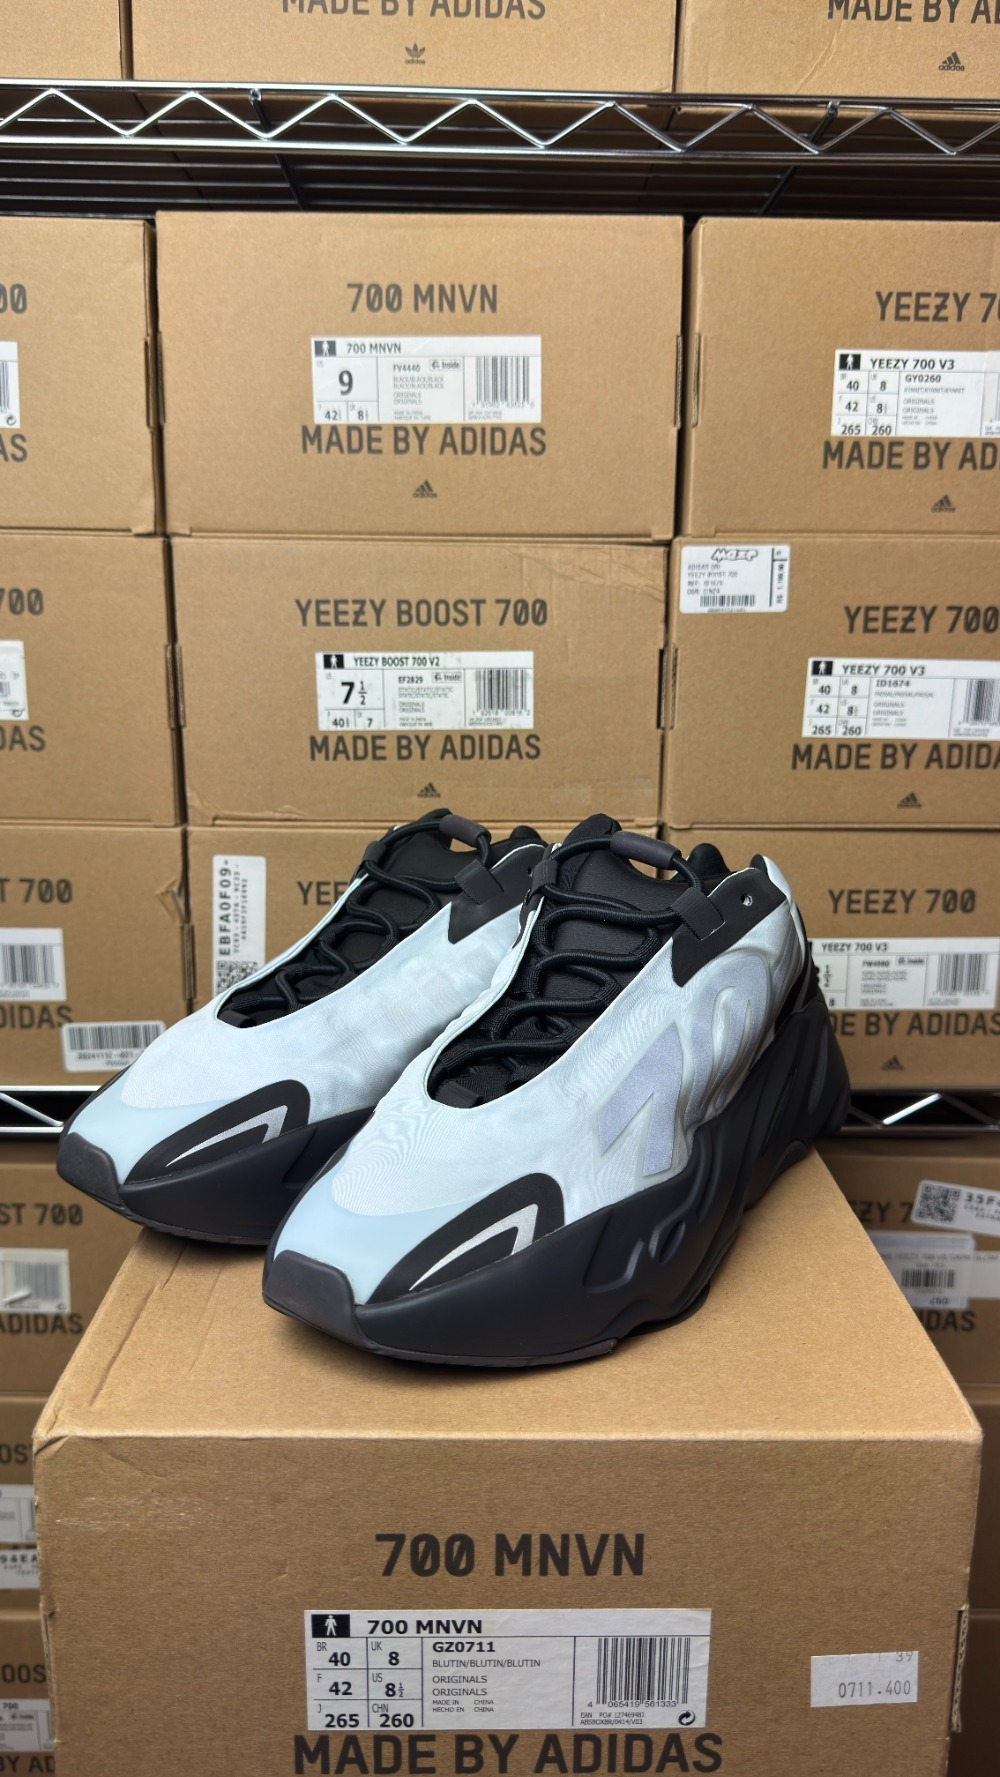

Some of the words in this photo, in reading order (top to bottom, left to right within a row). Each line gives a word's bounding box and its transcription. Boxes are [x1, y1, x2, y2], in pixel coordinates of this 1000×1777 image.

[430, 0, 546, 20] ADIDAS
[828, 0, 912, 22] MADE
[923, 0, 960, 23] BY
[346, 283, 403, 313] 700
[413, 284, 498, 313] MNVN
[876, 291, 971, 322] YEEZY
[979, 293, 1000, 323] 7
[346, 343, 366, 354] 700
[369, 343, 402, 354] MNVN
[393, 364, 421, 373] FV4440
[870, 358, 909, 369] YEEZY
[912, 358, 936, 370] 700
[940, 359, 955, 370] V3
[338, 369, 354, 397] 9
[904, 374, 942, 383] GY0260
[846, 380, 860, 391] 40
[879, 381, 887, 391] 8
[845, 402, 859, 412] 42
[841, 425, 861, 435] 265
[872, 425, 892, 435] 260
[301, 425, 383, 455] MADE
[393, 426, 430, 455] BY
[439, 427, 547, 456] ADIDAS
[822, 440, 904, 469] MADE
[912, 441, 951, 470] BY
[958, 442, 1000, 471] AD
[294, 599, 386, 627] YEEZY
[397, 599, 486, 627] BOOST
[495, 599, 548, 627] 700
[844, 606, 938, 634] YEEZY
[945, 606, 1000, 634] 700
[354, 656, 379, 667] YEEZY
[382, 656, 409, 667] BOOST
[412, 656, 427, 667] 700
[429, 656, 440, 667] V2
[842, 664, 880, 676] YEEZY
[883, 665, 905, 676] 700
[910, 665, 926, 676] V3
[398, 676, 423, 684] EF2829
[876, 680, 910, 688] ID1674
[818, 685, 831, 694] 40
[851, 685, 858, 695] 8
[816, 704, 830, 714] 42
[367, 718, 373, 727] 7
[812, 725, 831, 735] 265
[842, 726, 862, 736] 260
[309, 735, 387, 761] MADE
[396, 735, 431, 761] BY
[439, 734, 541, 760] ADIDAS
[791, 744, 872, 770] MADE
[880, 744, 918, 770] BY
[18, 878, 73, 904] 700
[827, 889, 917, 914] YEEZY
[924, 888, 977, 914] 700
[821, 942, 852, 952] YEEZY
[854, 942, 872, 952] 700
[875, 942, 888, 952] V3
[865, 1012, 900, 1036] BY
[906, 1012, 1000, 1036] ADIDAS
[34, 1203, 83, 1226] 700
[0, 1443, 33, 1465] OS
[374, 1533, 475, 1577] 700
[494, 1533, 645, 1577] MNVN
[367, 1620, 408, 1634] 700
[415, 1619, 482, 1634] MNVN
[316, 1641, 327, 1651] BR
[371, 1641, 383, 1651] UK
[432, 1641, 495, 1652] GZ0711
[328, 1652, 351, 1666] 40
[388, 1651, 400, 1666] 8
[432, 1659, 541, 1668] BLUTIN/BLUTIN/BLUTIN
[317, 1674, 322, 1683] F
[372, 1673, 383, 1683] US
[432, 1675, 487, 1684] ORIGINALS
[328, 1681, 353, 1695] 42
[432, 1688, 487, 1696] ORIGINALS
[838, 1680, 911, 1698] 0711.400
[316, 1703, 322, 1713] J
[372, 1703, 389, 1713] CHN
[644, 1700, 677, 1708] 561333
[325, 1713, 359, 1728] 265
[379, 1713, 414, 1728] 260
[293, 1735, 436, 1776] MADE
[455, 1734, 520, 1775] BY
[534, 1733, 723, 1775] ADIDAS
[0, 1755, 19, 1773] Y
